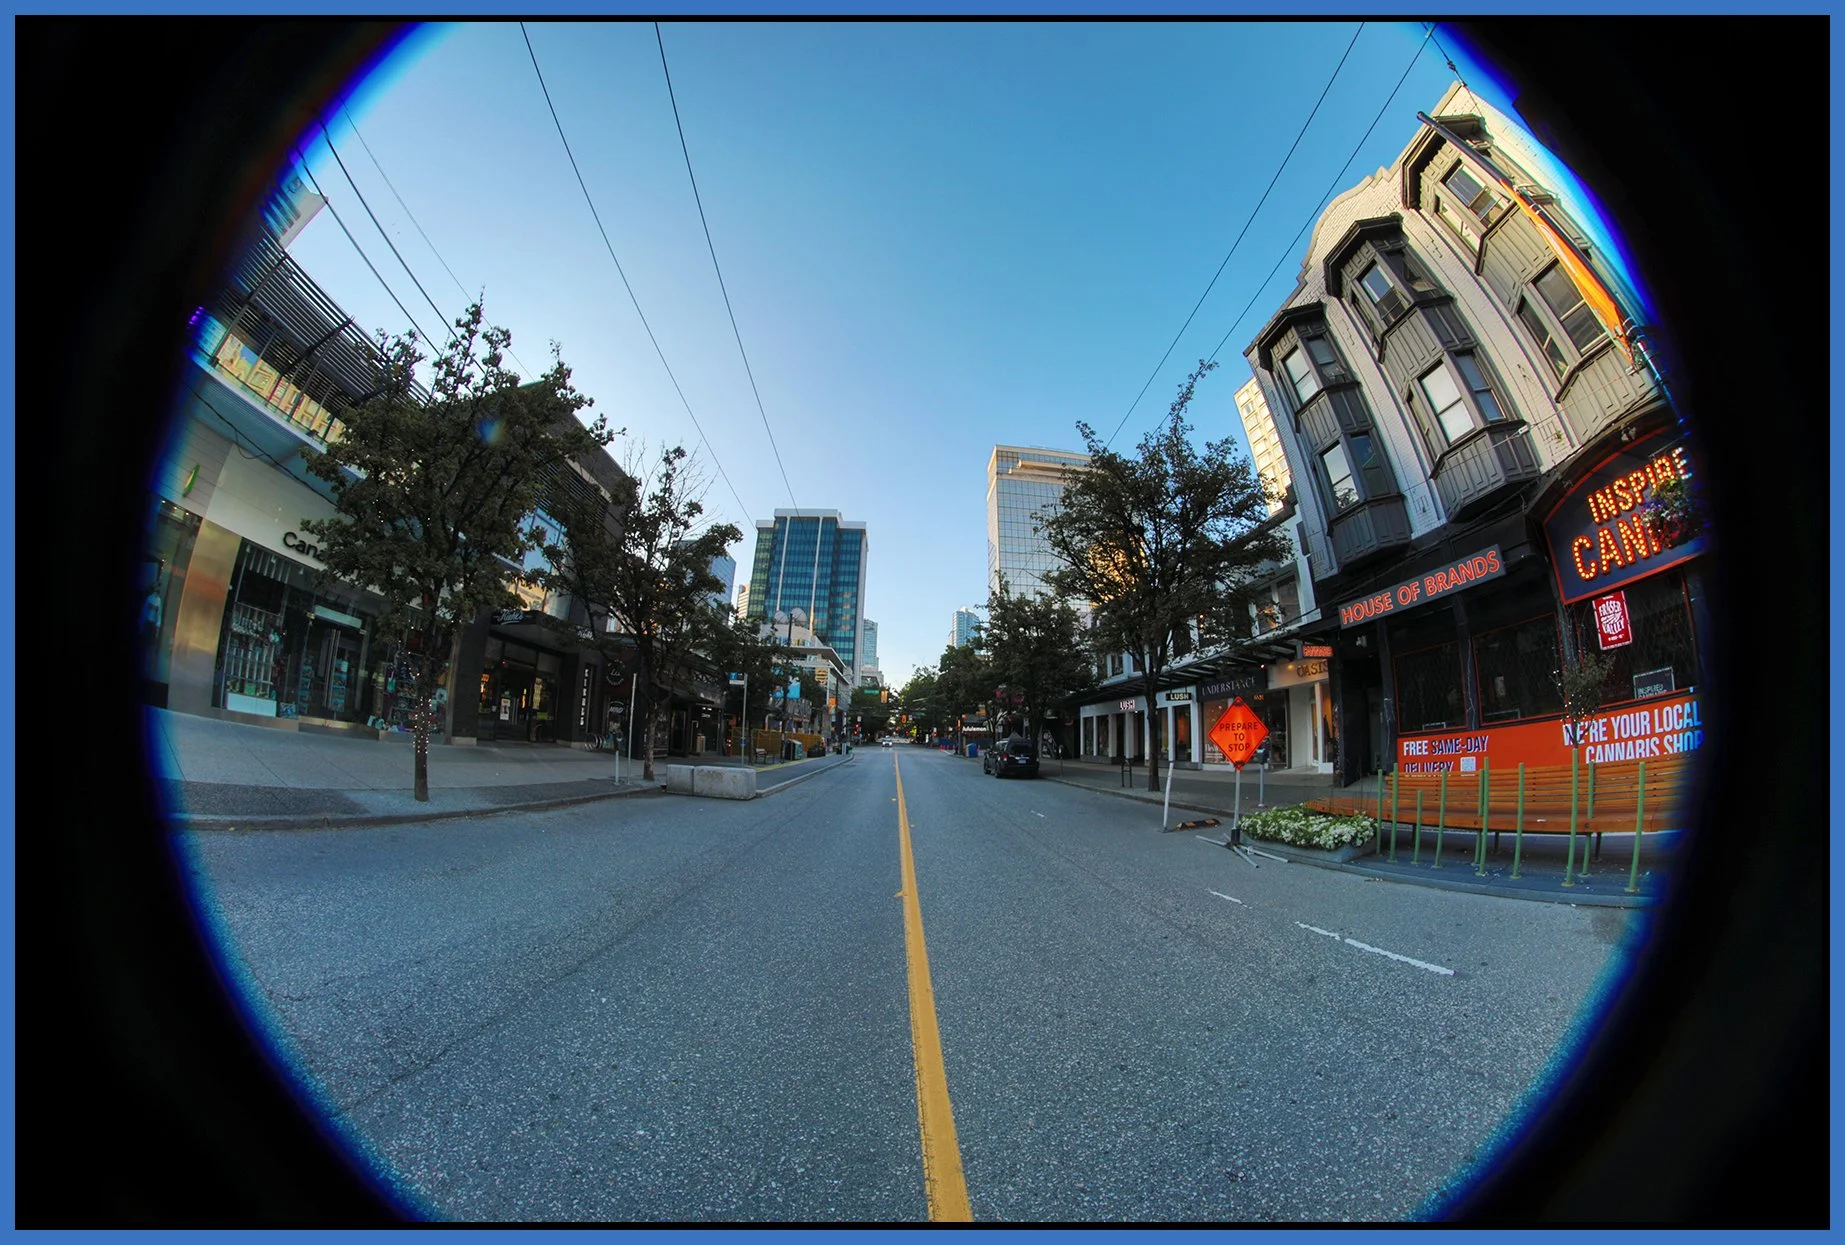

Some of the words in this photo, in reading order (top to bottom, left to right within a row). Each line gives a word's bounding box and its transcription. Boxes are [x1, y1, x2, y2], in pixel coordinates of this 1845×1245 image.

[1341, 592, 1393, 624] HOUSE
[1397, 581, 1420, 606] OF
[1424, 550, 1500, 597] BRANDS
[1598, 600, 1623, 617] FRASER
[1602, 617, 1625, 635] VALLEY
[1297, 660, 1329, 678] OASIS
[1202, 675, 1256, 697] UNDERSTANCE
[1120, 699, 1136, 710] LUSH
[1220, 721, 1258, 731] PREPARE
[1562, 717, 1608, 746] WE'RE
[1611, 710, 1652, 740] YOUR
[1653, 700, 1703, 734] LOCAL
[1234, 732, 1245, 742] TO
[1403, 740, 1429, 756] FREE
[1431, 735, 1489, 756] SAME-DAY
[1228, 743, 1250, 753] STOP
[1585, 736, 1660, 764] CANNABIS
